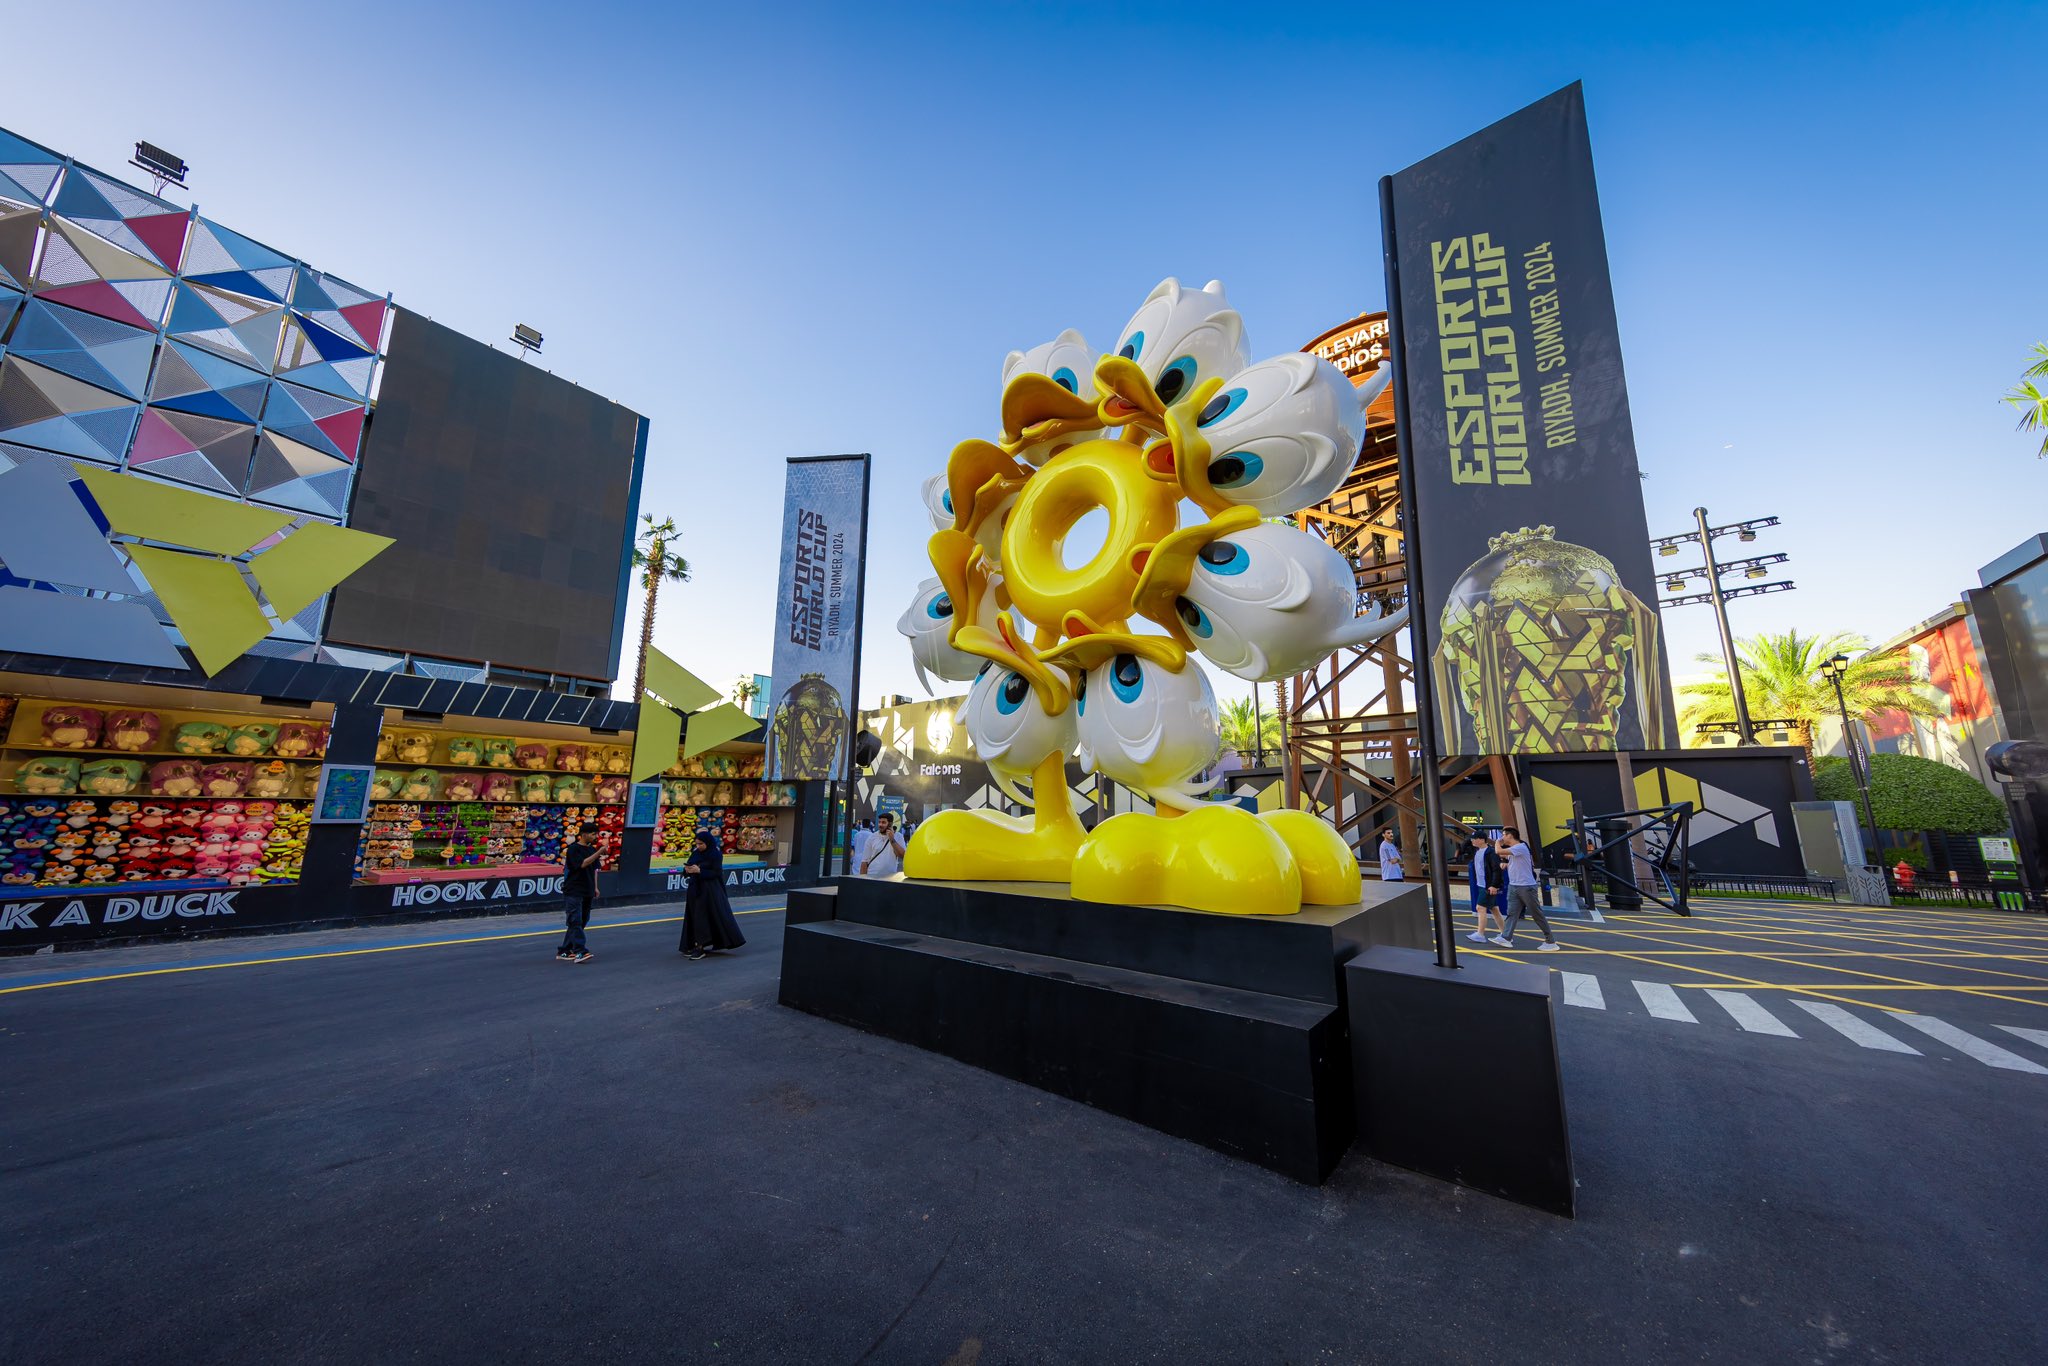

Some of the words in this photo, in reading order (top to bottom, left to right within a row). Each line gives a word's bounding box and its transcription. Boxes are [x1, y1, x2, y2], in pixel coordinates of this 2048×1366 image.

[1472, 232, 1512, 318] CUP
[1524, 240, 1557, 291] 2024
[1530, 289, 1567, 373] SUMMER
[1431, 236, 1492, 485] ESPORTS
[1482, 326, 1532, 486] WORLD
[1540, 371, 1577, 449] RIYADH,
[813, 514, 828, 562] CUP
[833, 532, 844, 555] 2024
[790, 508, 814, 646] ESPORTS
[830, 562, 843, 598] SUMMER
[808, 565, 825, 651] WORLD
[828, 601, 841, 637] RIYADH,
[920, 764, 961, 776] Falcons
[951, 777, 960, 785] HQ
[392, 881, 488, 907] HOOK
[491, 880, 512, 899] A
[726, 871, 739, 886] A
[742, 868, 787, 885] DUCK
[49, 900, 91, 927] A
[103, 891, 240, 923] DUCK
